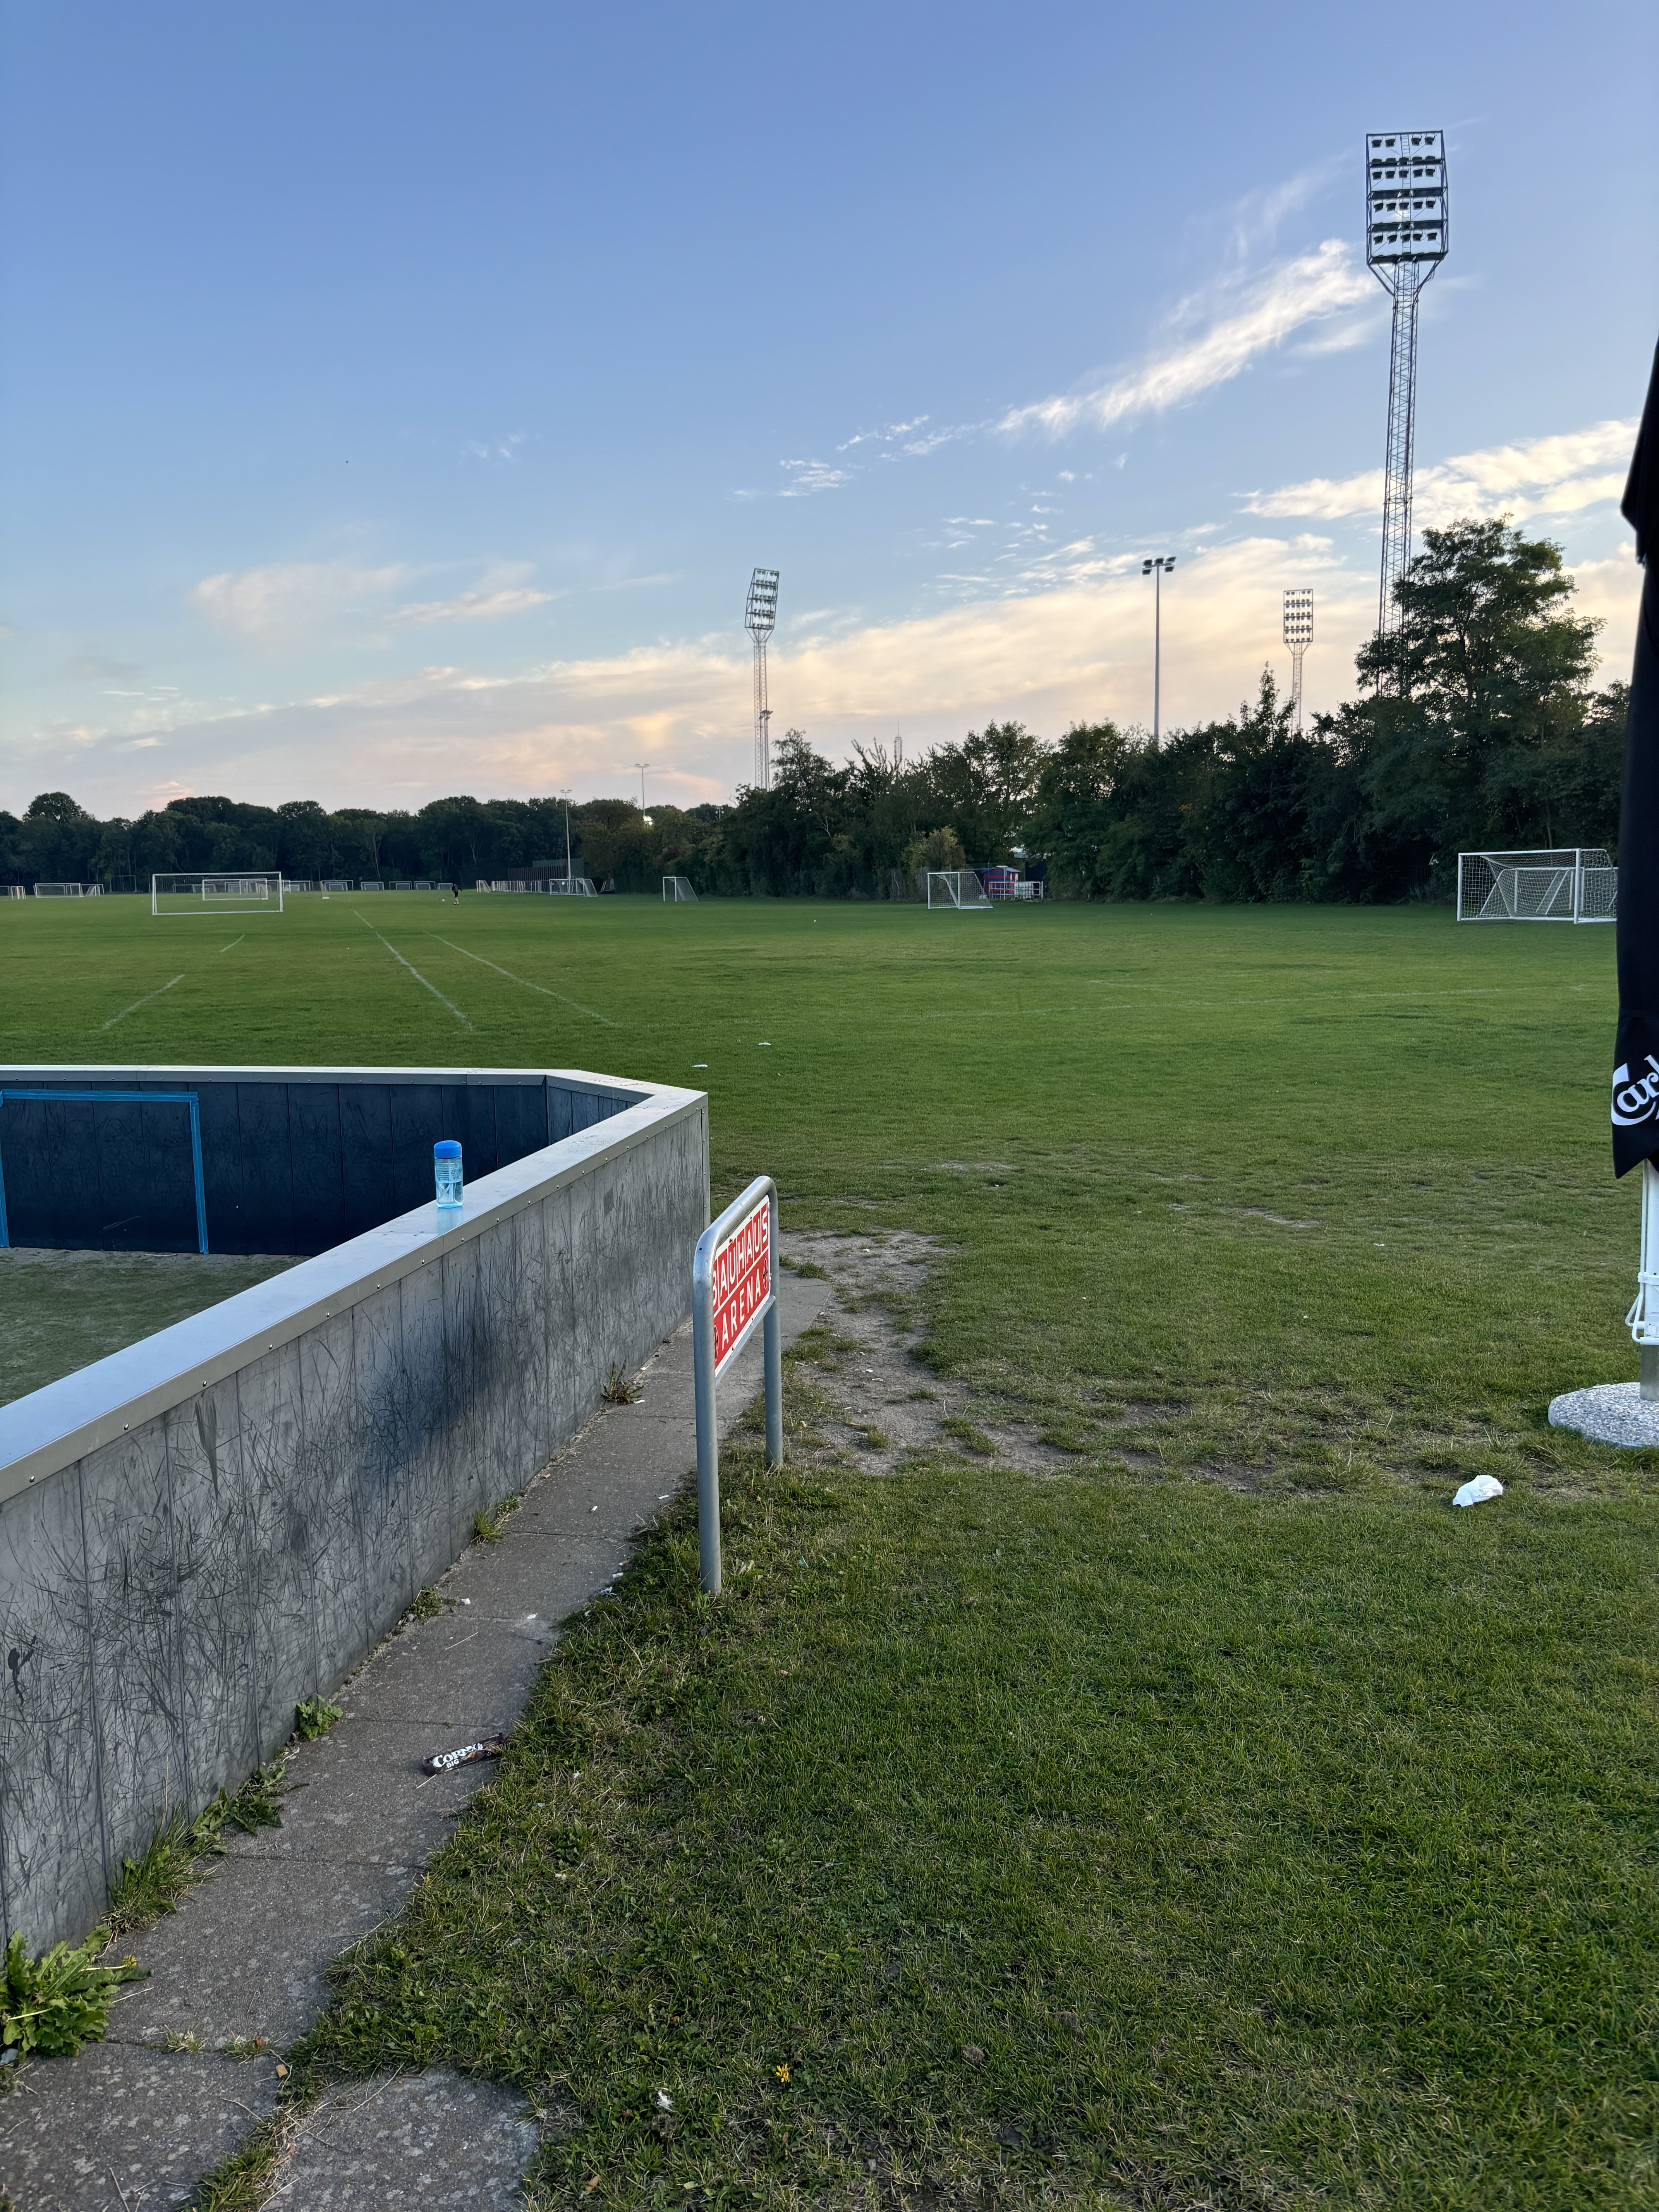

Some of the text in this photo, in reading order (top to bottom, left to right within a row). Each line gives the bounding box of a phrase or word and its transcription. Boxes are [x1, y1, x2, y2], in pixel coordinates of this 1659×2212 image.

[713, 1211, 768, 1306] BAUHAUS
[721, 1268, 761, 1351] ARENA
[446, 1759, 460, 1769] BIG
